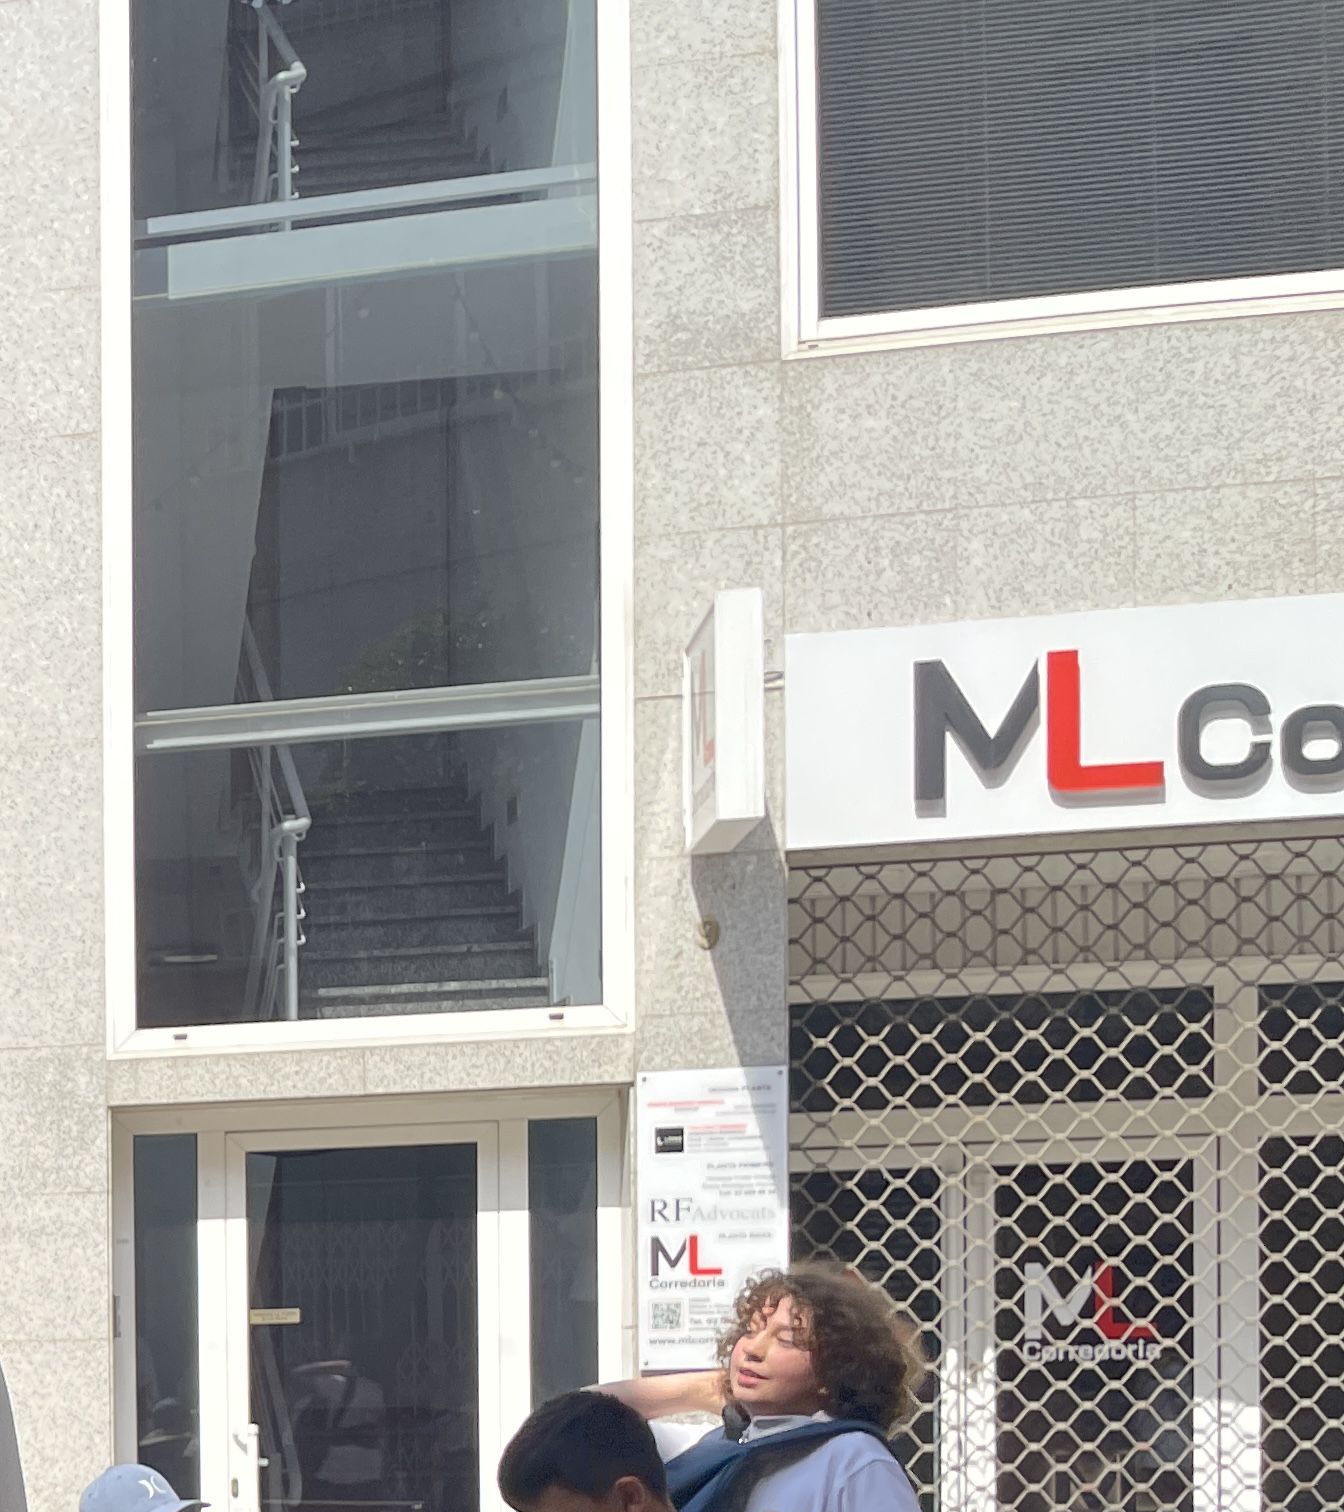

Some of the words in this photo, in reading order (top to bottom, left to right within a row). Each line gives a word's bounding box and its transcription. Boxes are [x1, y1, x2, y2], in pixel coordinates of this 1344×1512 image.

[913, 650, 1166, 818] ML
[650, 1234, 723, 1277] ML
[1024, 1260, 1157, 1340] ML
